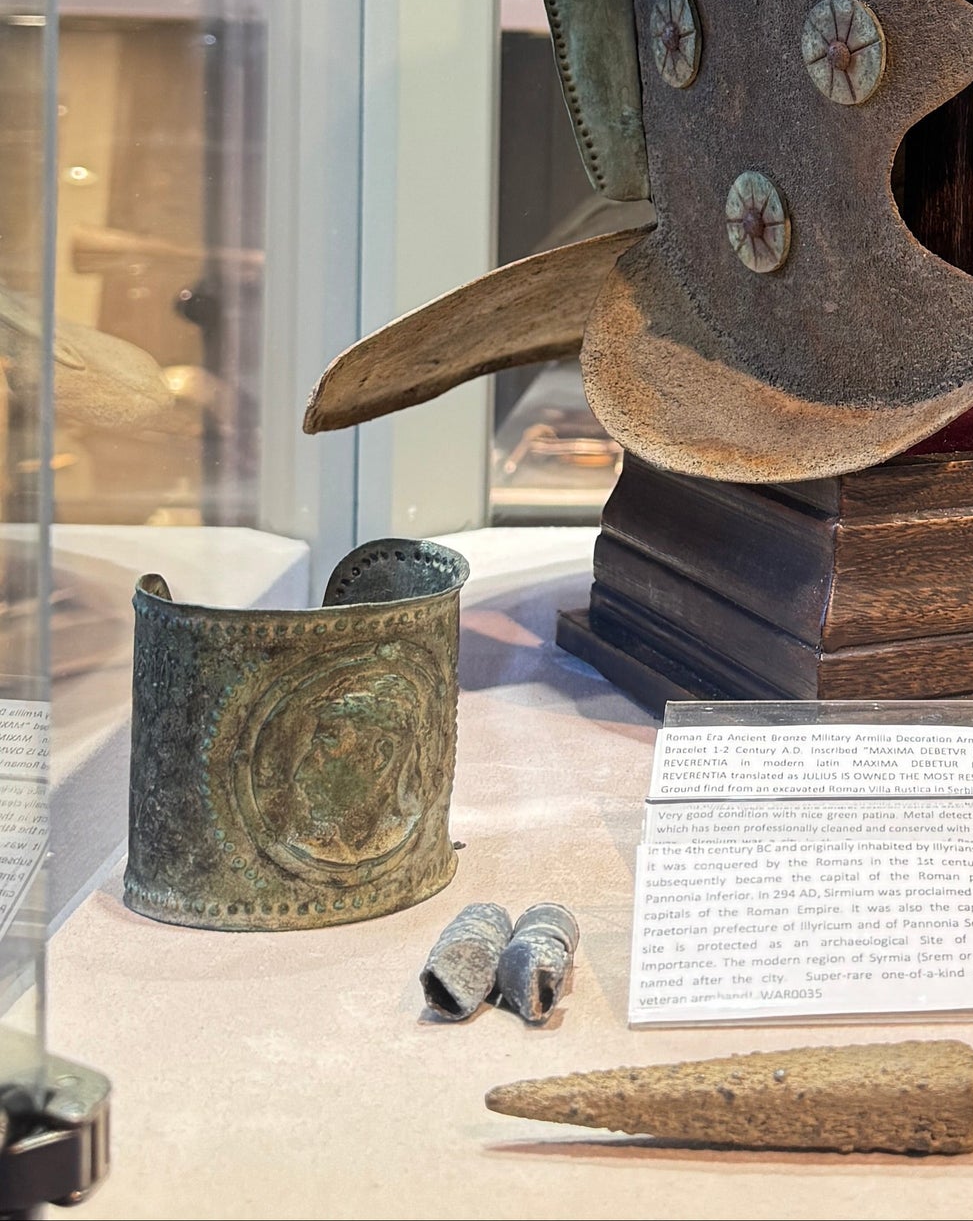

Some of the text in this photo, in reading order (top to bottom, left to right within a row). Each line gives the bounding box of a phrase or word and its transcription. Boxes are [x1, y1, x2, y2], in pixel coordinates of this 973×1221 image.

[728, 734, 766, 742] Ancient
[812, 734, 851, 743] Military
[855, 734, 891, 742] Armilla
[896, 735, 952, 743] Decoration
[736, 746, 776, 755] Century
[921, 747, 966, 755] DEBETVR
[663, 772, 726, 780] REVERENTIA
[803, 772, 837, 780] JULIUS
[841, 772, 850, 780] IS
[658, 812, 683, 821] Very
[686, 811, 714, 821] good
[718, 810, 769, 818] condition
[772, 810, 797, 818] with
[827, 812, 857, 821] green
[646, 893, 701, 904] Pannonia
[759, 891, 769, 899] In
[773, 890, 795, 899] 294
[799, 889, 820, 899] AD,
[824, 888, 874, 897] Sirmium
[906, 887, 971, 898] proclaimed
[644, 926, 707, 936] Praetorian
[713, 923, 778, 936] prefecture
[783, 922, 795, 931] of
[801, 921, 852, 932] Illyricum
[858, 920, 880, 929] and
[886, 919, 897, 929] of
[903, 919, 959, 928] Pannonia
[643, 945, 664, 954] site
[676, 942, 685, 952] is
[697, 940, 757, 952] protected
[769, 941, 782, 949] as
[821, 936, 908, 947] archaeological
[920, 936, 943, 945] Site
[955, 934, 966, 944] of
[642, 961, 716, 972] Importance.
[723, 957, 746, 967] The
[752, 956, 800, 966] modern
[807, 954, 845, 966] region
[851, 953, 863, 963] of
[869, 953, 911, 964] Syrmia
[917, 952, 953, 963] (Srem
[760, 988, 822, 1000] WAR0035
